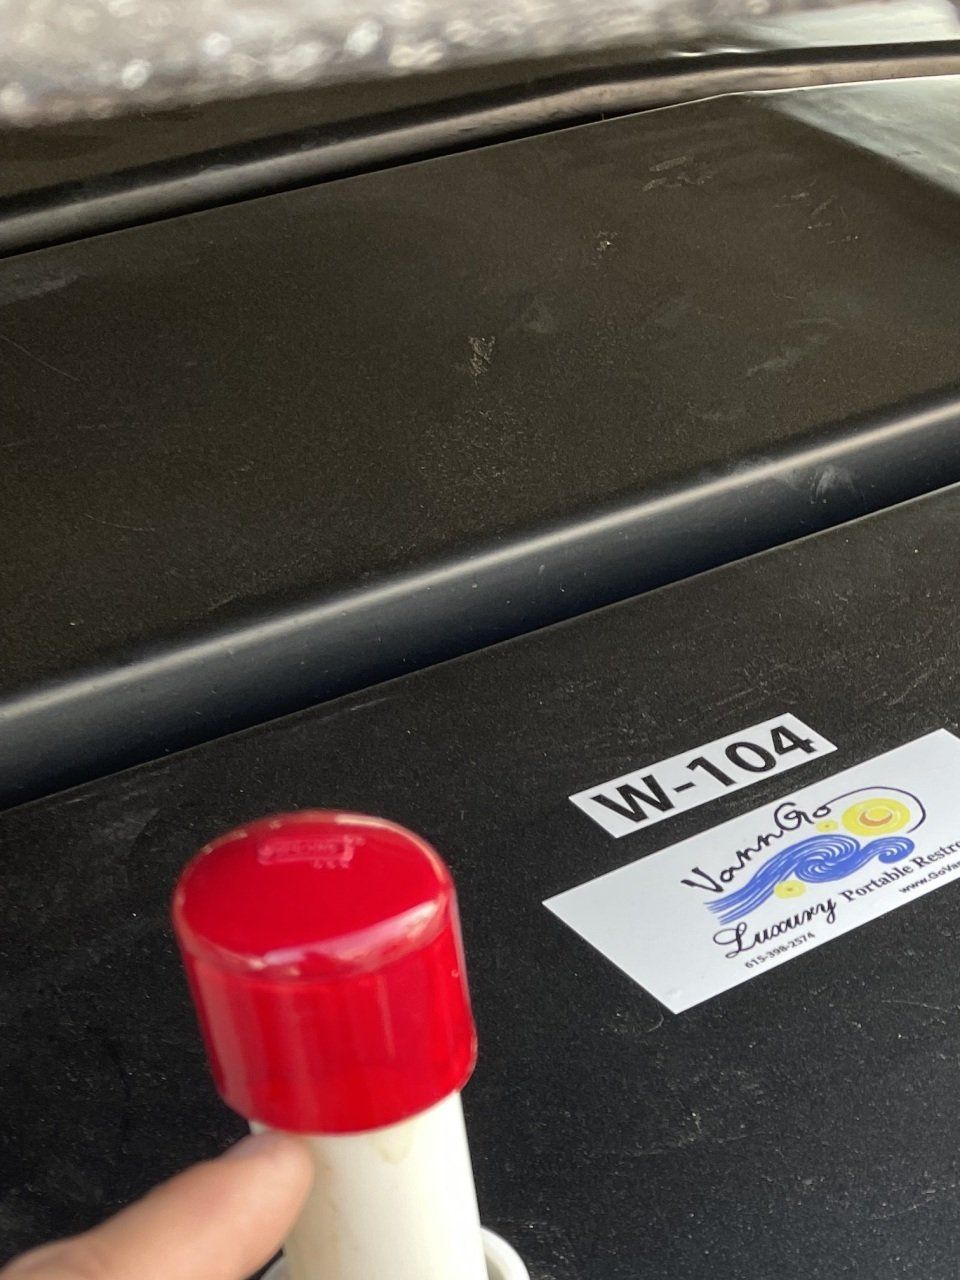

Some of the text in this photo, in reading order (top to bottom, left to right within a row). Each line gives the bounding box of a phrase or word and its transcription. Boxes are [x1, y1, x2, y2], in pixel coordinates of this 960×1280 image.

[591, 725, 818, 823] W-104
[680, 799, 836, 893] VannGo
[713, 897, 837, 959] Luxury
[838, 862, 914, 903] Portable
[744, 931, 816, 969] 615-398-2574
